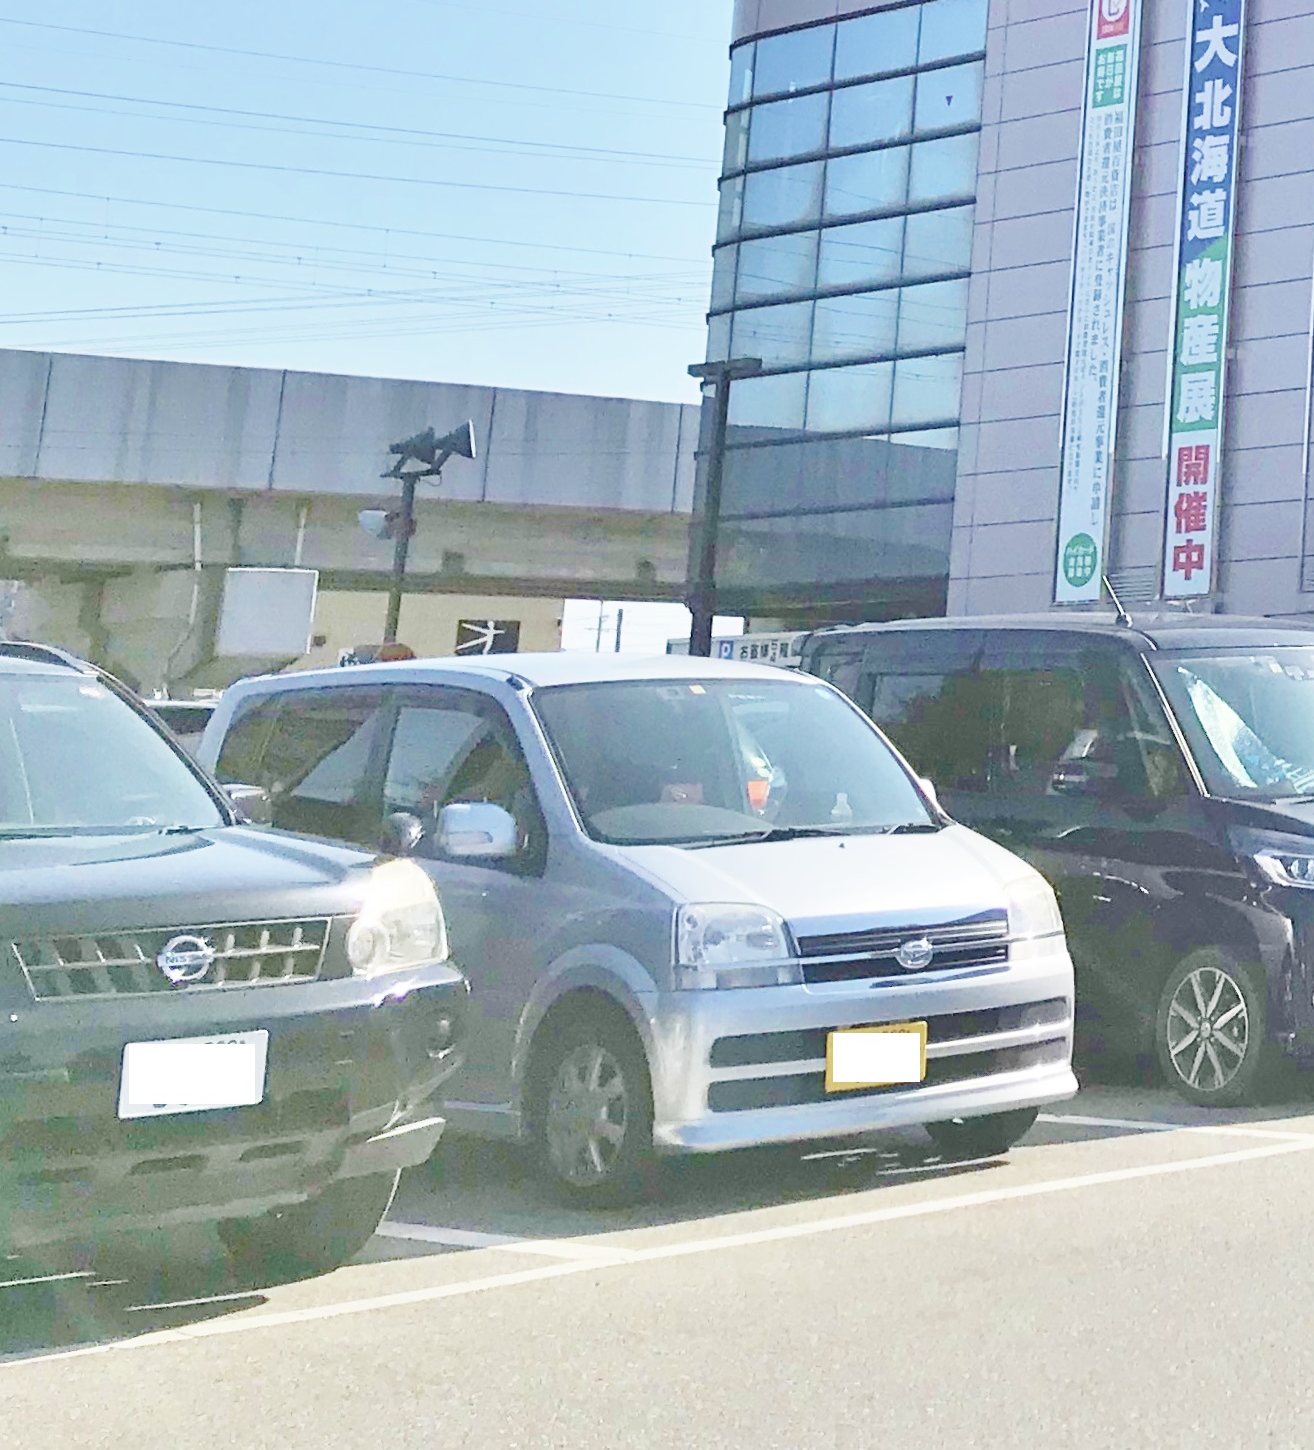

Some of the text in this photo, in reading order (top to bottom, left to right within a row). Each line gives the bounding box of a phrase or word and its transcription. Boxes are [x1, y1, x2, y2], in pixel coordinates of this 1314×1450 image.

[1171, 15, 1239, 581] 大北海道 物産展 開催中
